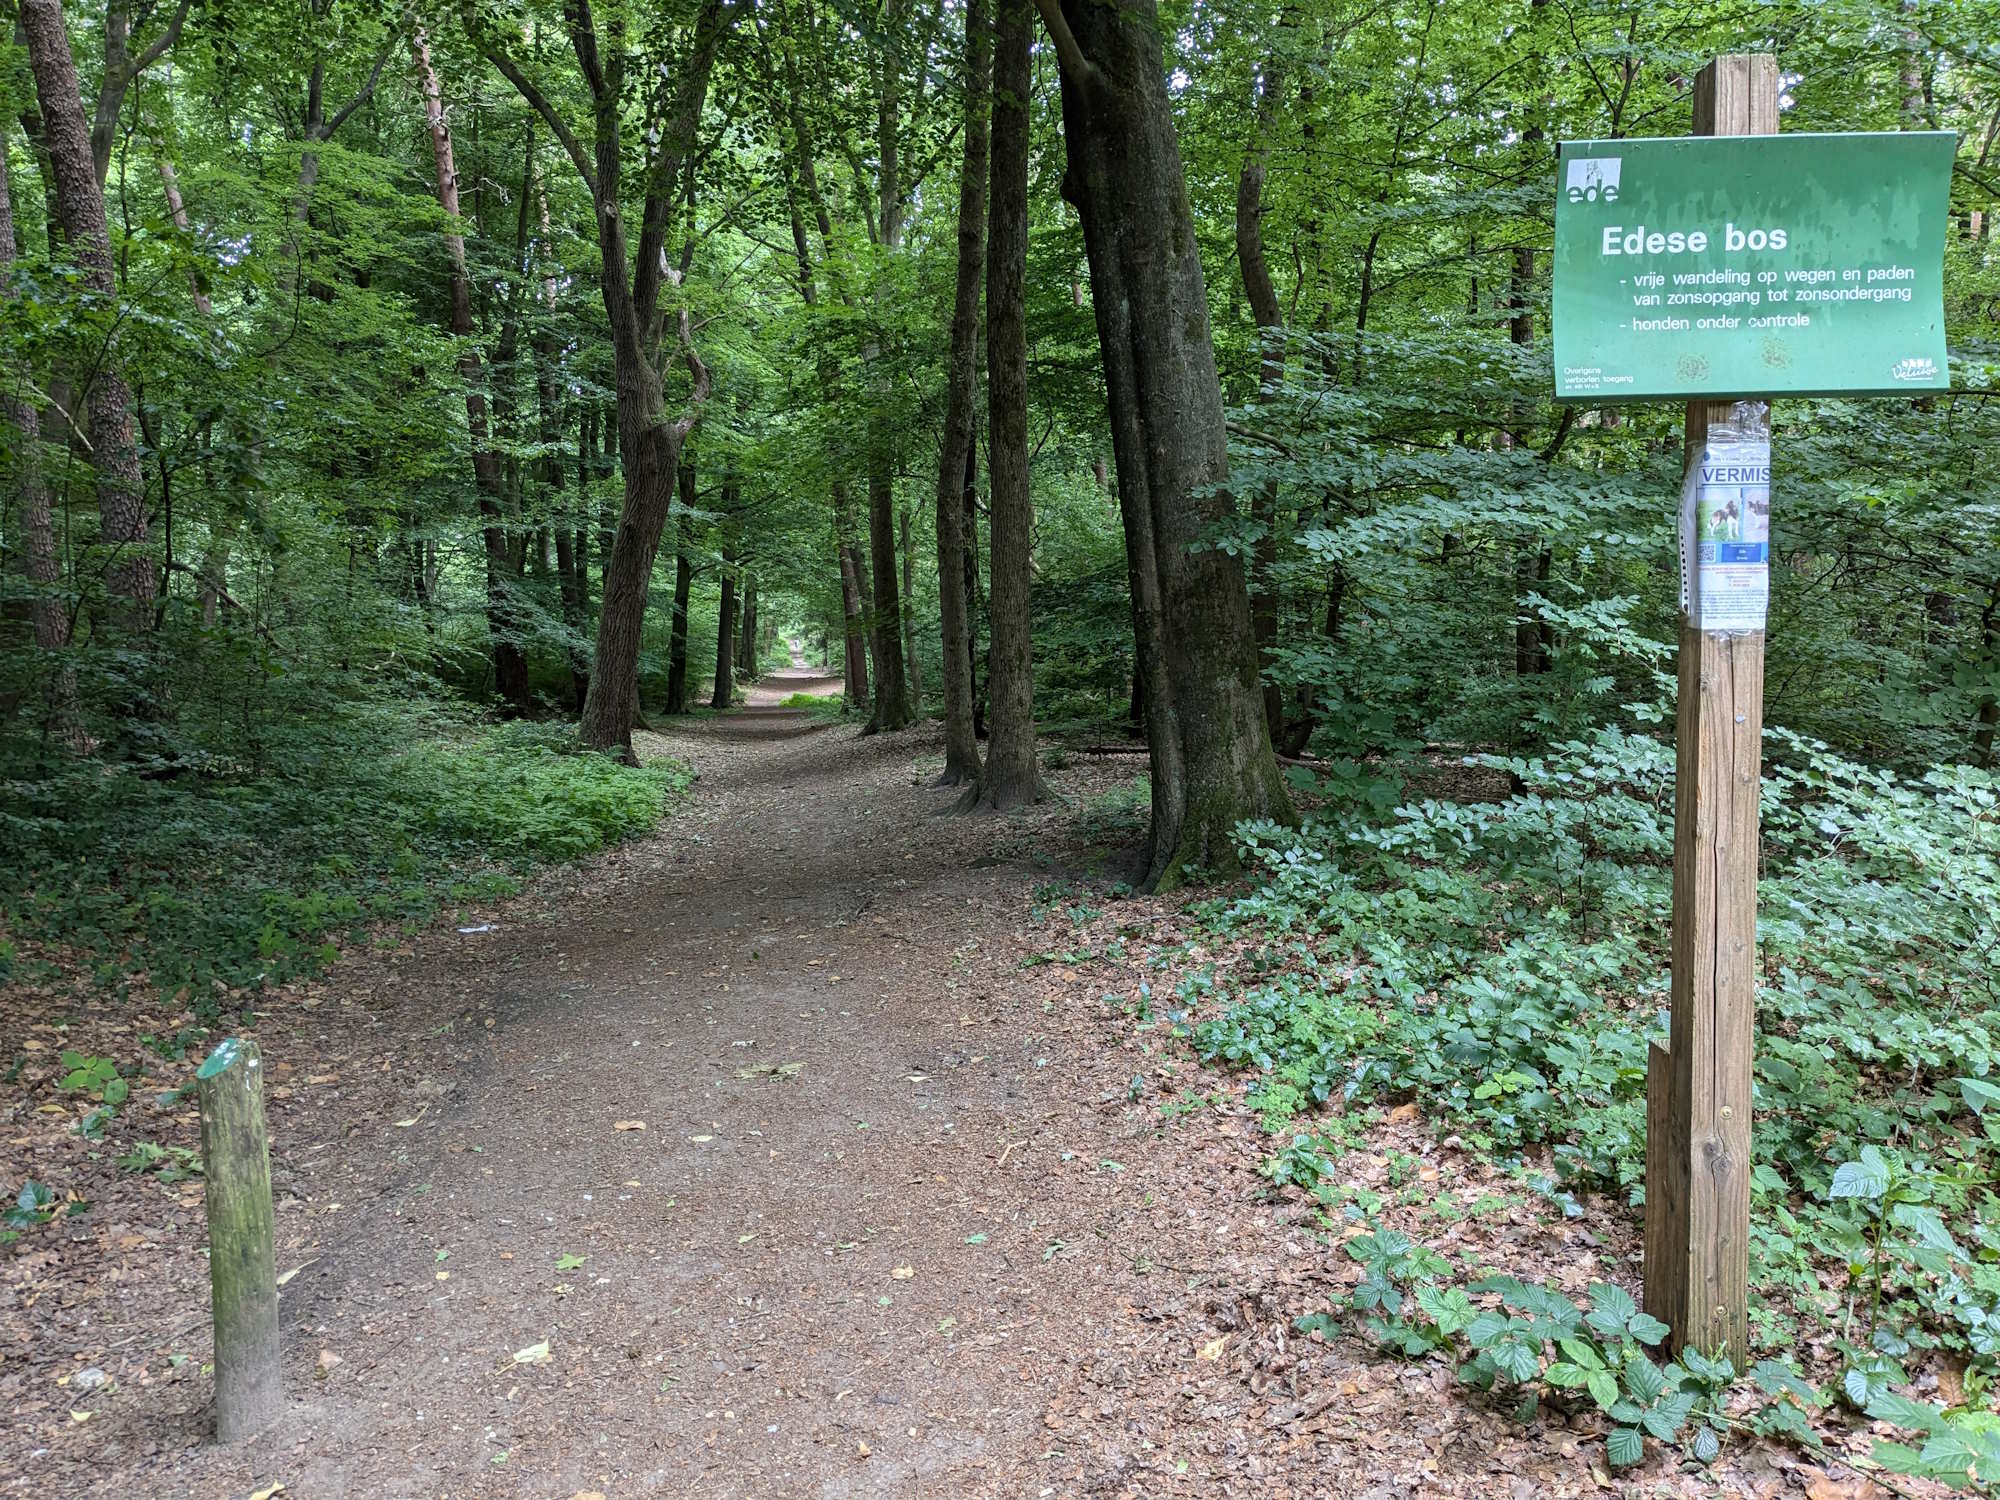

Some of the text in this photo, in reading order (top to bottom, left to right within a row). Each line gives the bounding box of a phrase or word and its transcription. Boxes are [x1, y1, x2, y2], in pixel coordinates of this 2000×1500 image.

[1567, 179, 1619, 204] ede
[1602, 222, 1788, 255] Edese bos
[1633, 272, 1665, 288] vrije
[1672, 270, 1750, 287] wandeling
[1757, 272, 1778, 286] op
[1784, 269, 1836, 285] wegen
[1842, 268, 1860, 281] en
[1867, 265, 1915, 283] paden
[1633, 285, 1912, 307] van zonsopgang tot zonsondergang
[1632, 315, 1689, 331] honden
[1696, 314, 1741, 329] onder
[1748, 312, 1810, 327] controle
